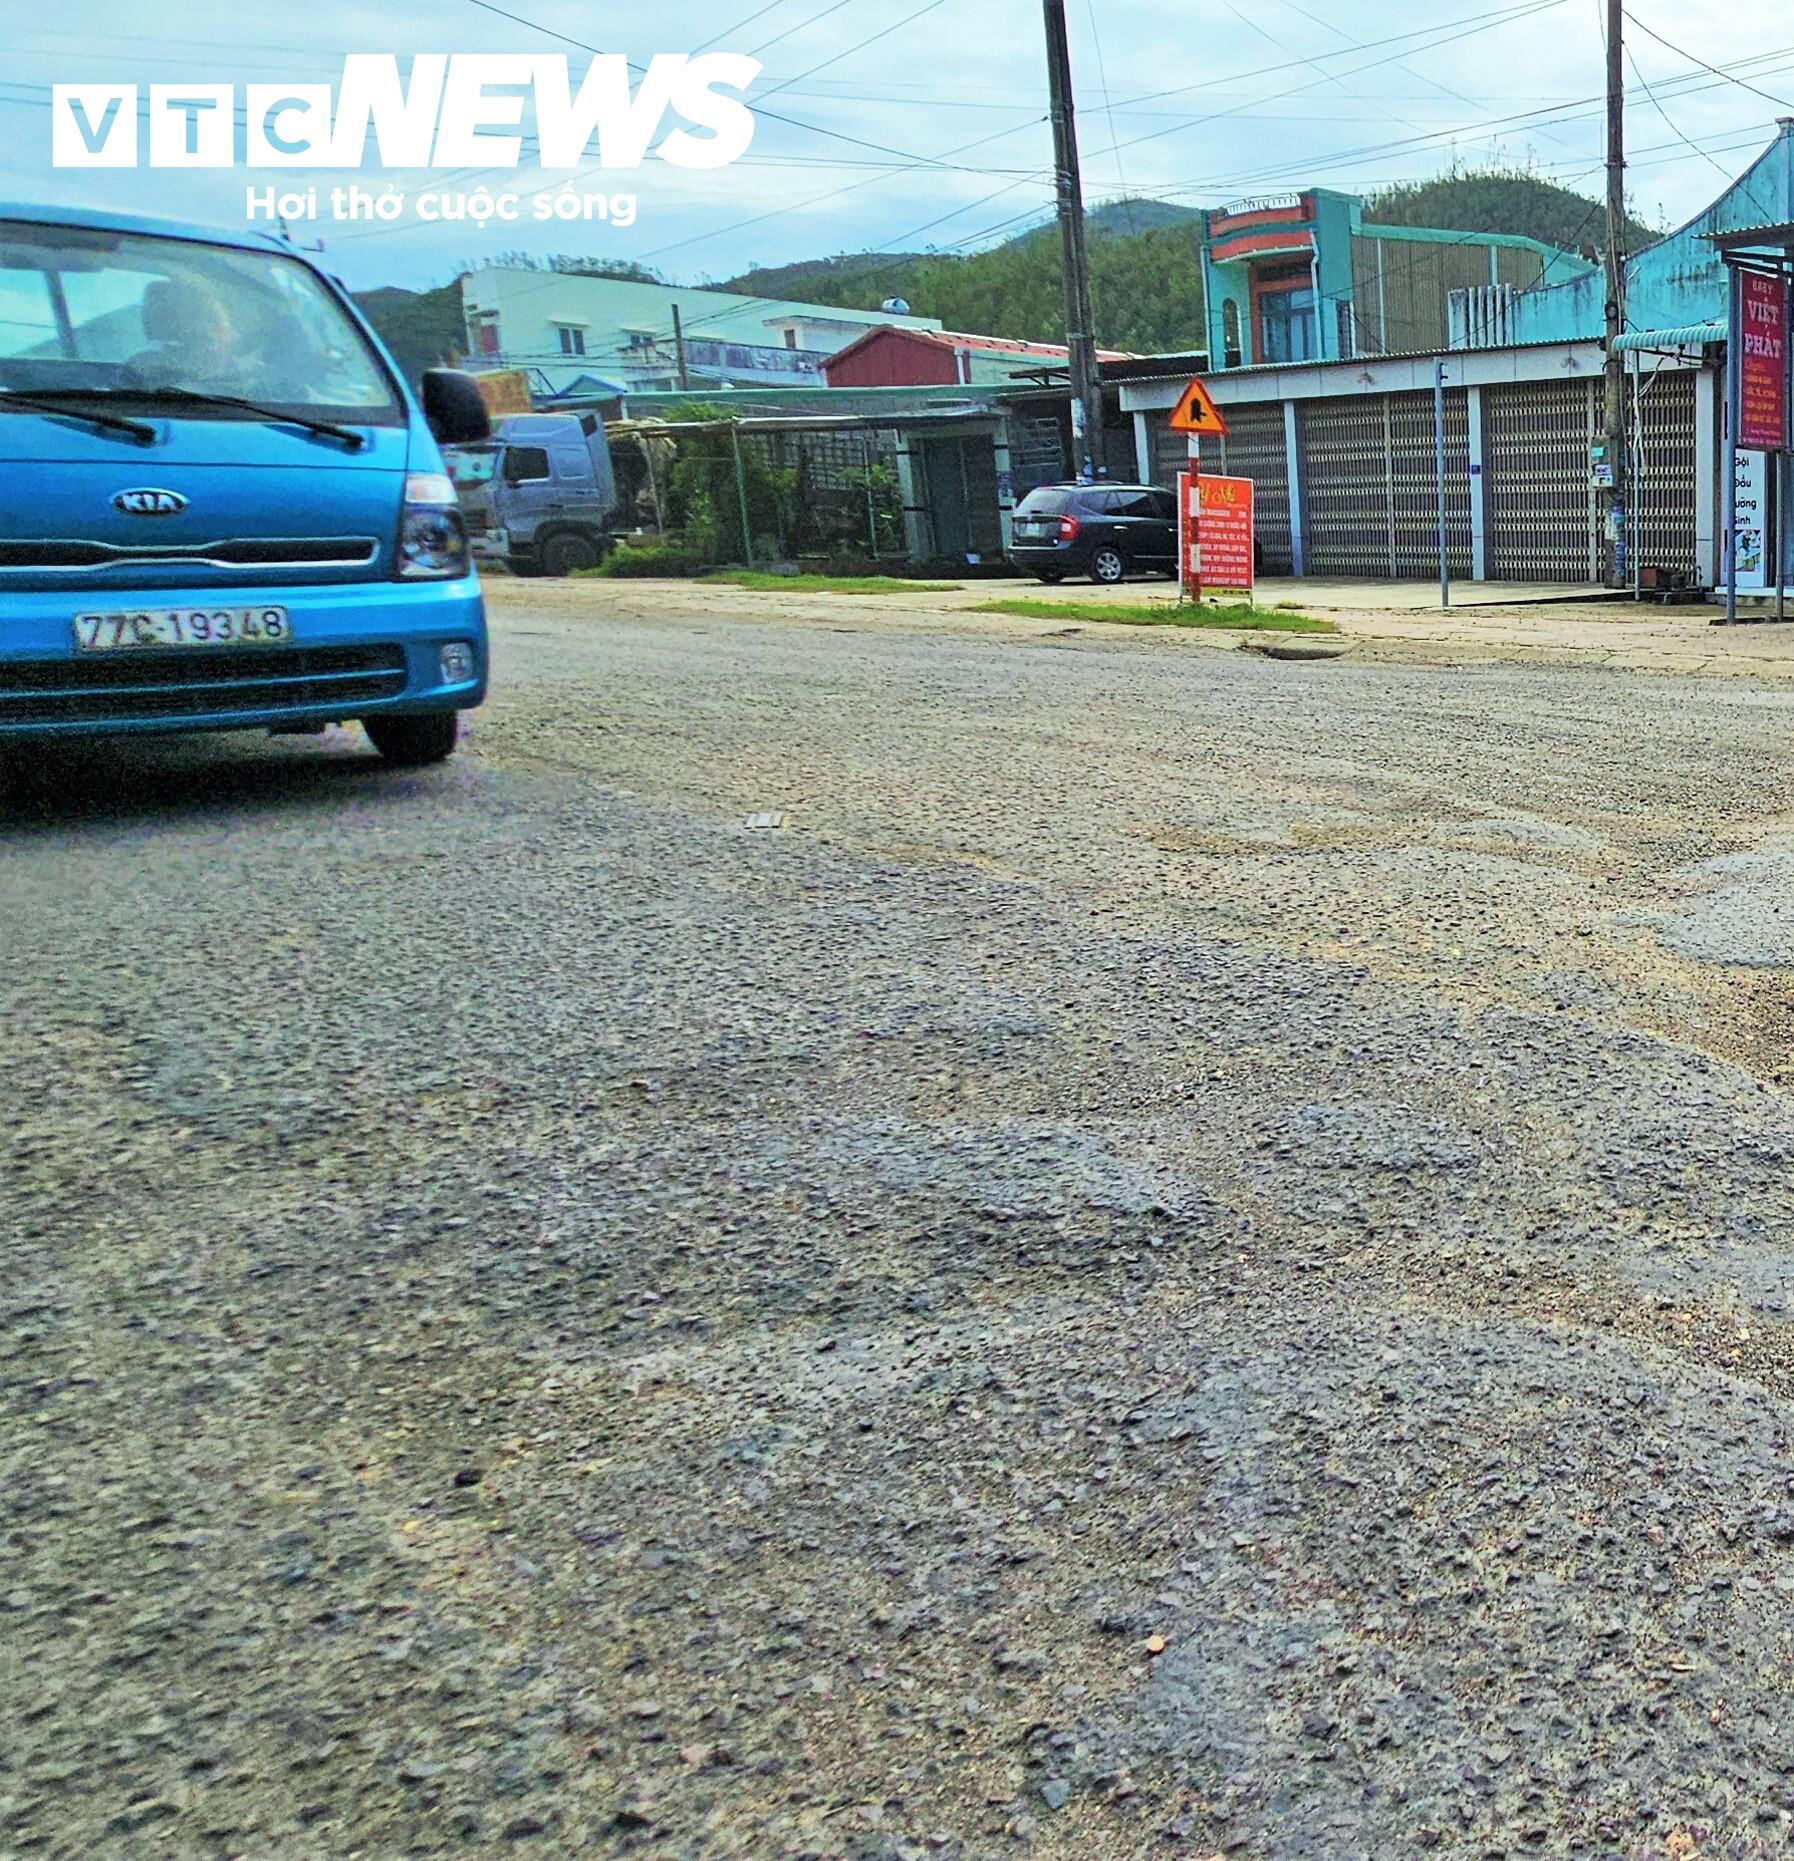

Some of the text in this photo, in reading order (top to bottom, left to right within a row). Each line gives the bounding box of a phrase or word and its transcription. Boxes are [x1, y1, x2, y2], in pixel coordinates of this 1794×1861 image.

[1752, 280, 1773, 296] BABY
[1747, 296, 1778, 329] VIỆT
[1744, 332, 1782, 360] PHÁT
[122, 494, 178, 511] KIA
